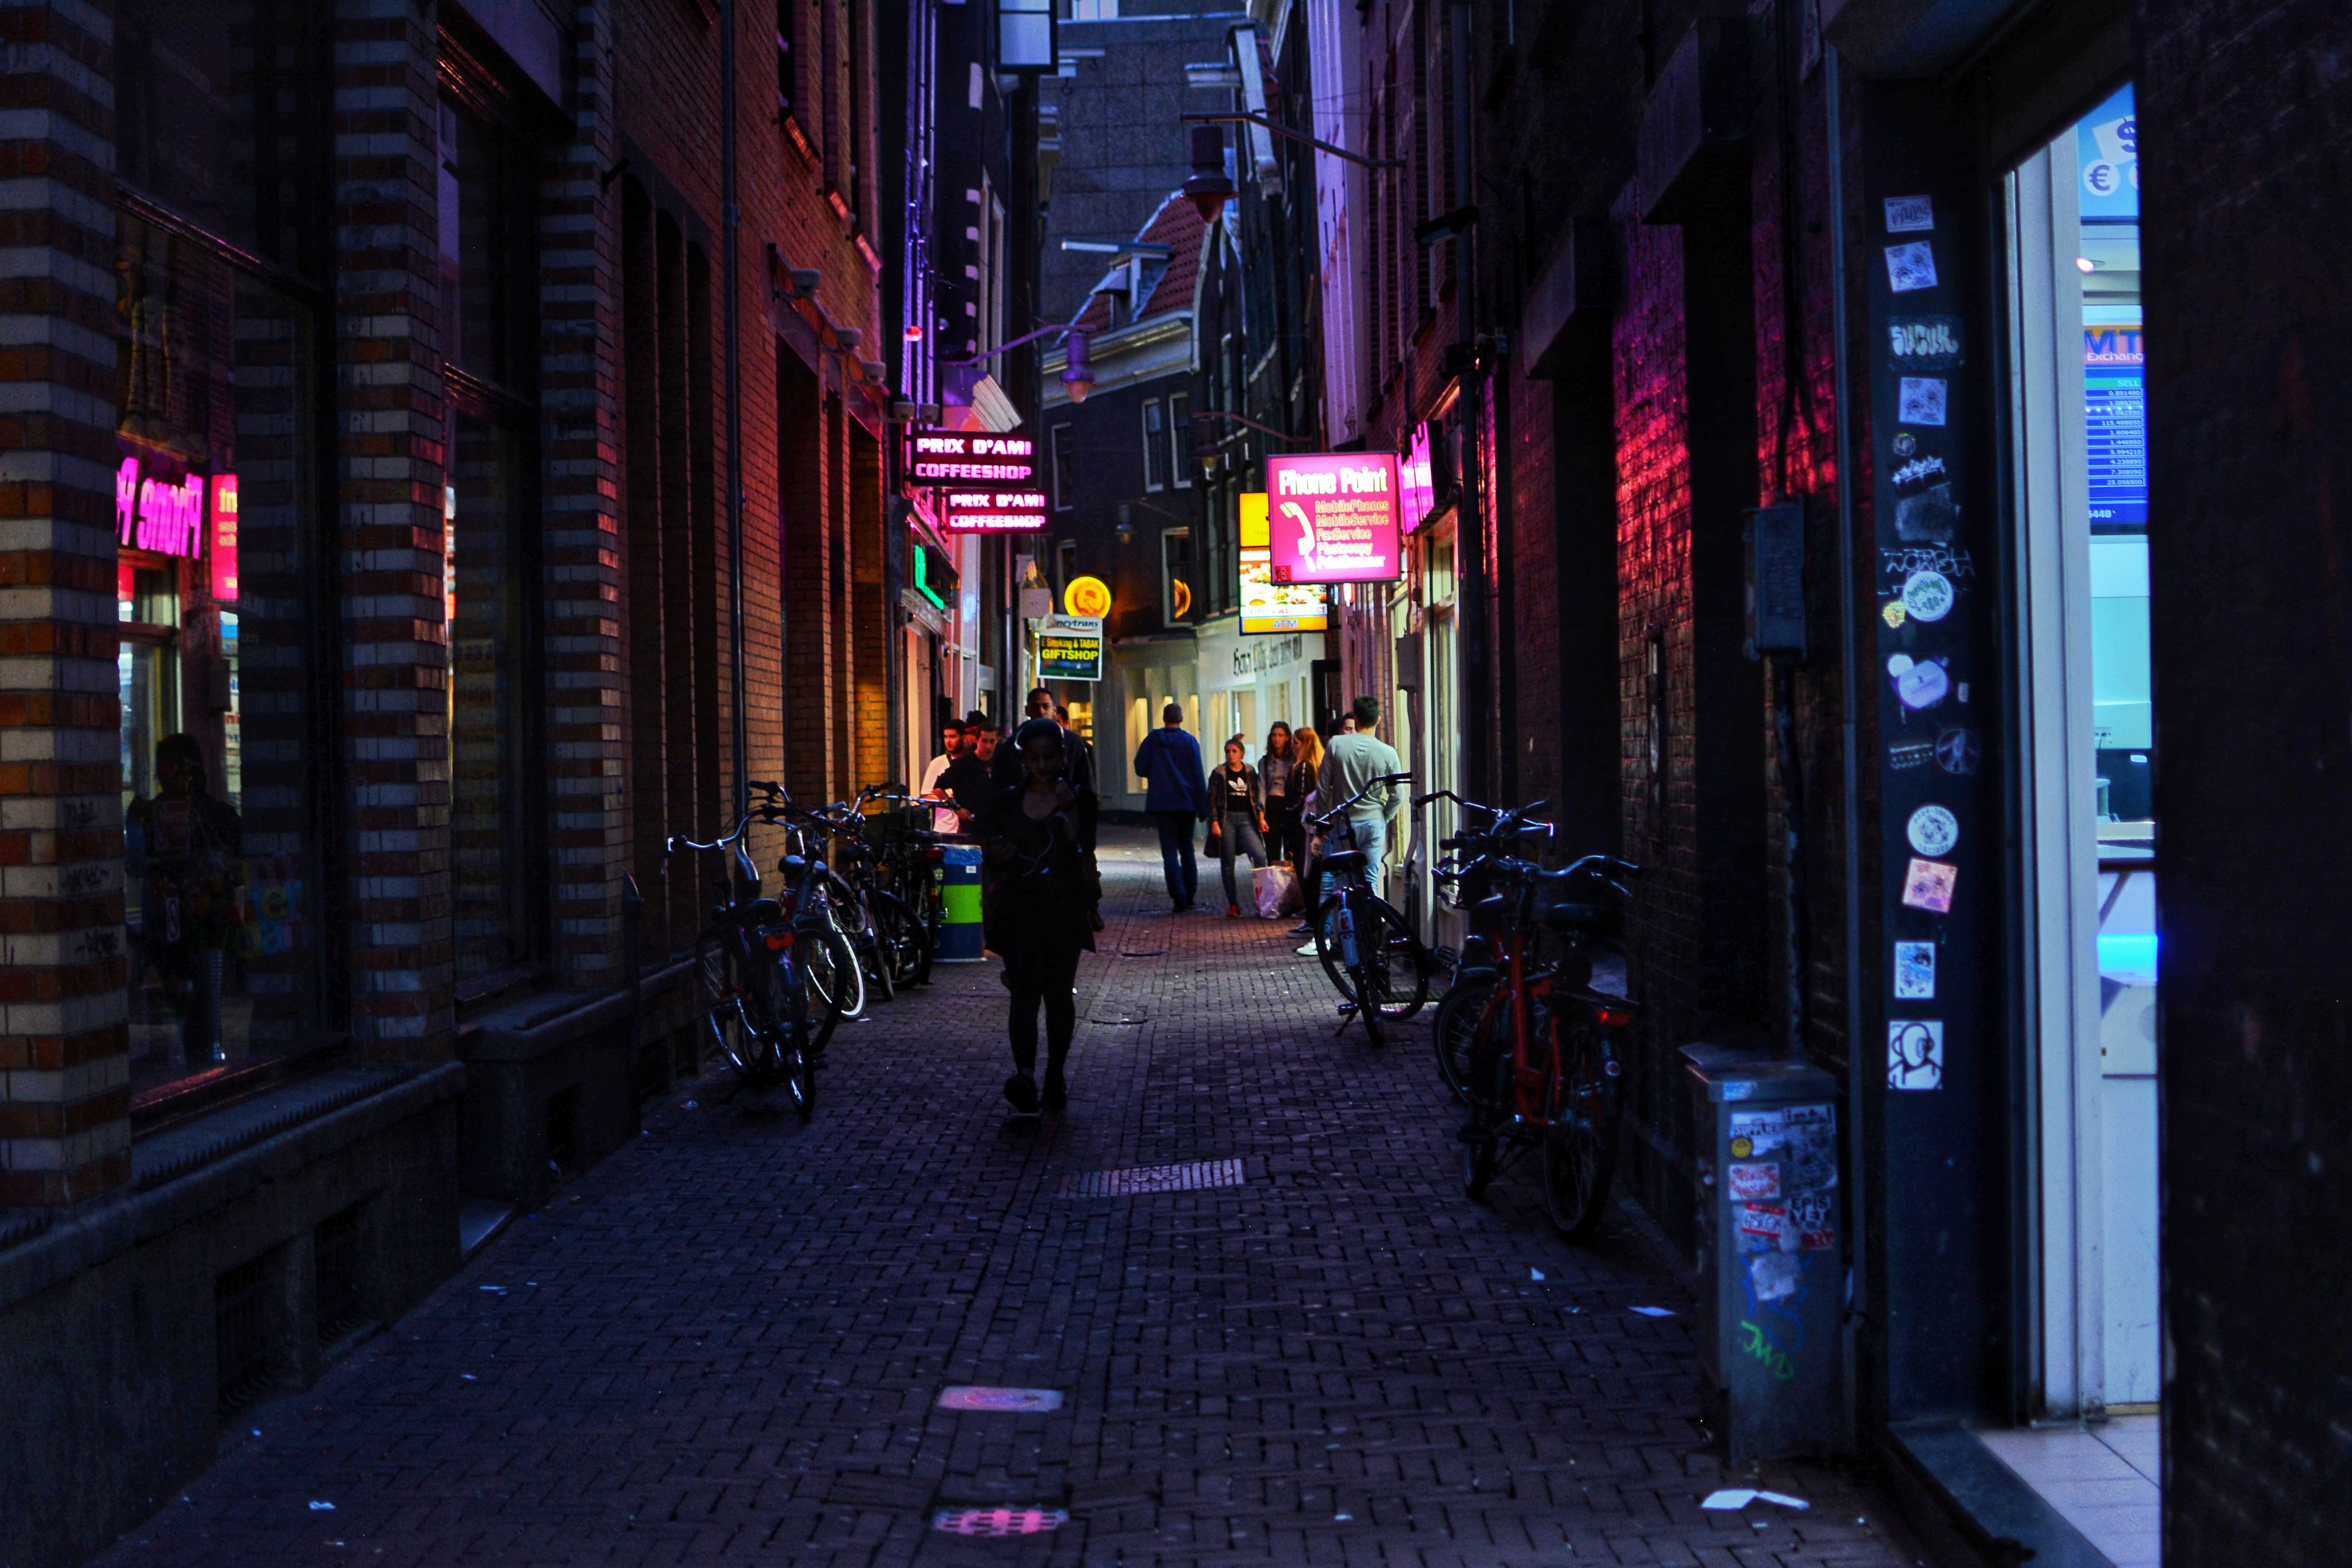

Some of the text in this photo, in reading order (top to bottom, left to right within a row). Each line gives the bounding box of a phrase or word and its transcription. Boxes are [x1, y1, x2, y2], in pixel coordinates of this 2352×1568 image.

[917, 438, 1031, 455] PRIX D'AMI
[916, 463, 1031, 479] COFFEESHOP
[1279, 466, 1388, 495] Phone Point
[950, 494, 1045, 507] PRIX D'AMI
[1315, 499, 1390, 514] MobilePhones
[949, 515, 1045, 528] COFFEESHOP
[1316, 513, 1389, 527] MobileService
[1316, 527, 1372, 541] FaxService
[1316, 541, 1373, 556] Photocopy
[1273, 620, 1298, 628] ATM
[1042, 648, 1099, 660] GIFTSHOP
